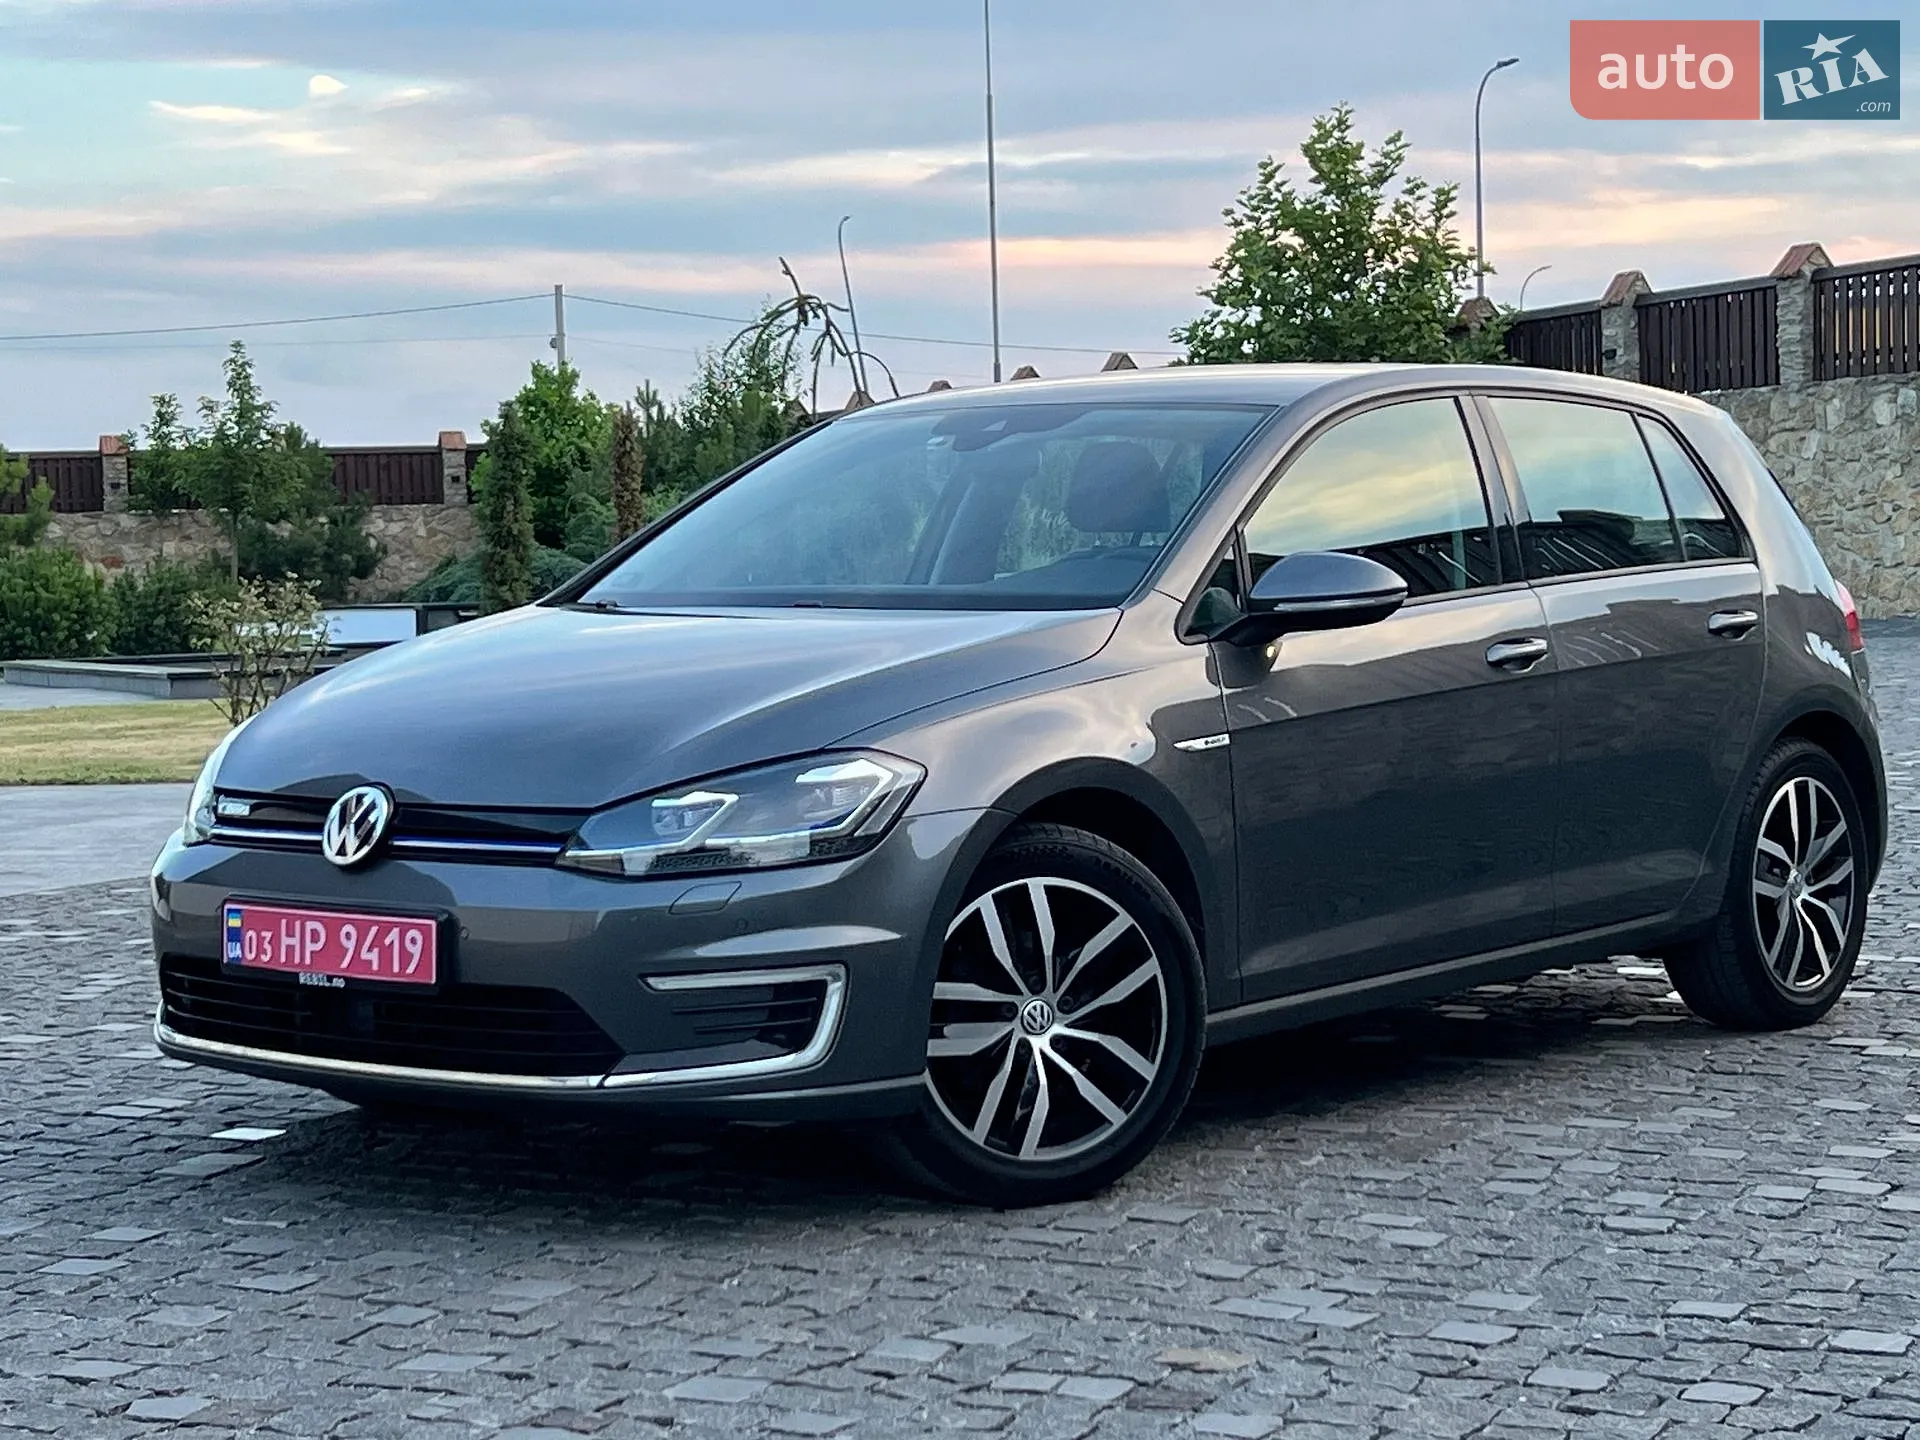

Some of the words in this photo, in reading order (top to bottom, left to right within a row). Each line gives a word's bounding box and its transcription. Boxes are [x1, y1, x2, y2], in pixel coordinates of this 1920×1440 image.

[227, 941, 242, 959] UA
[244, 929, 273, 963] 03
[280, 918, 327, 966] HP
[339, 923, 424, 975] 9419
